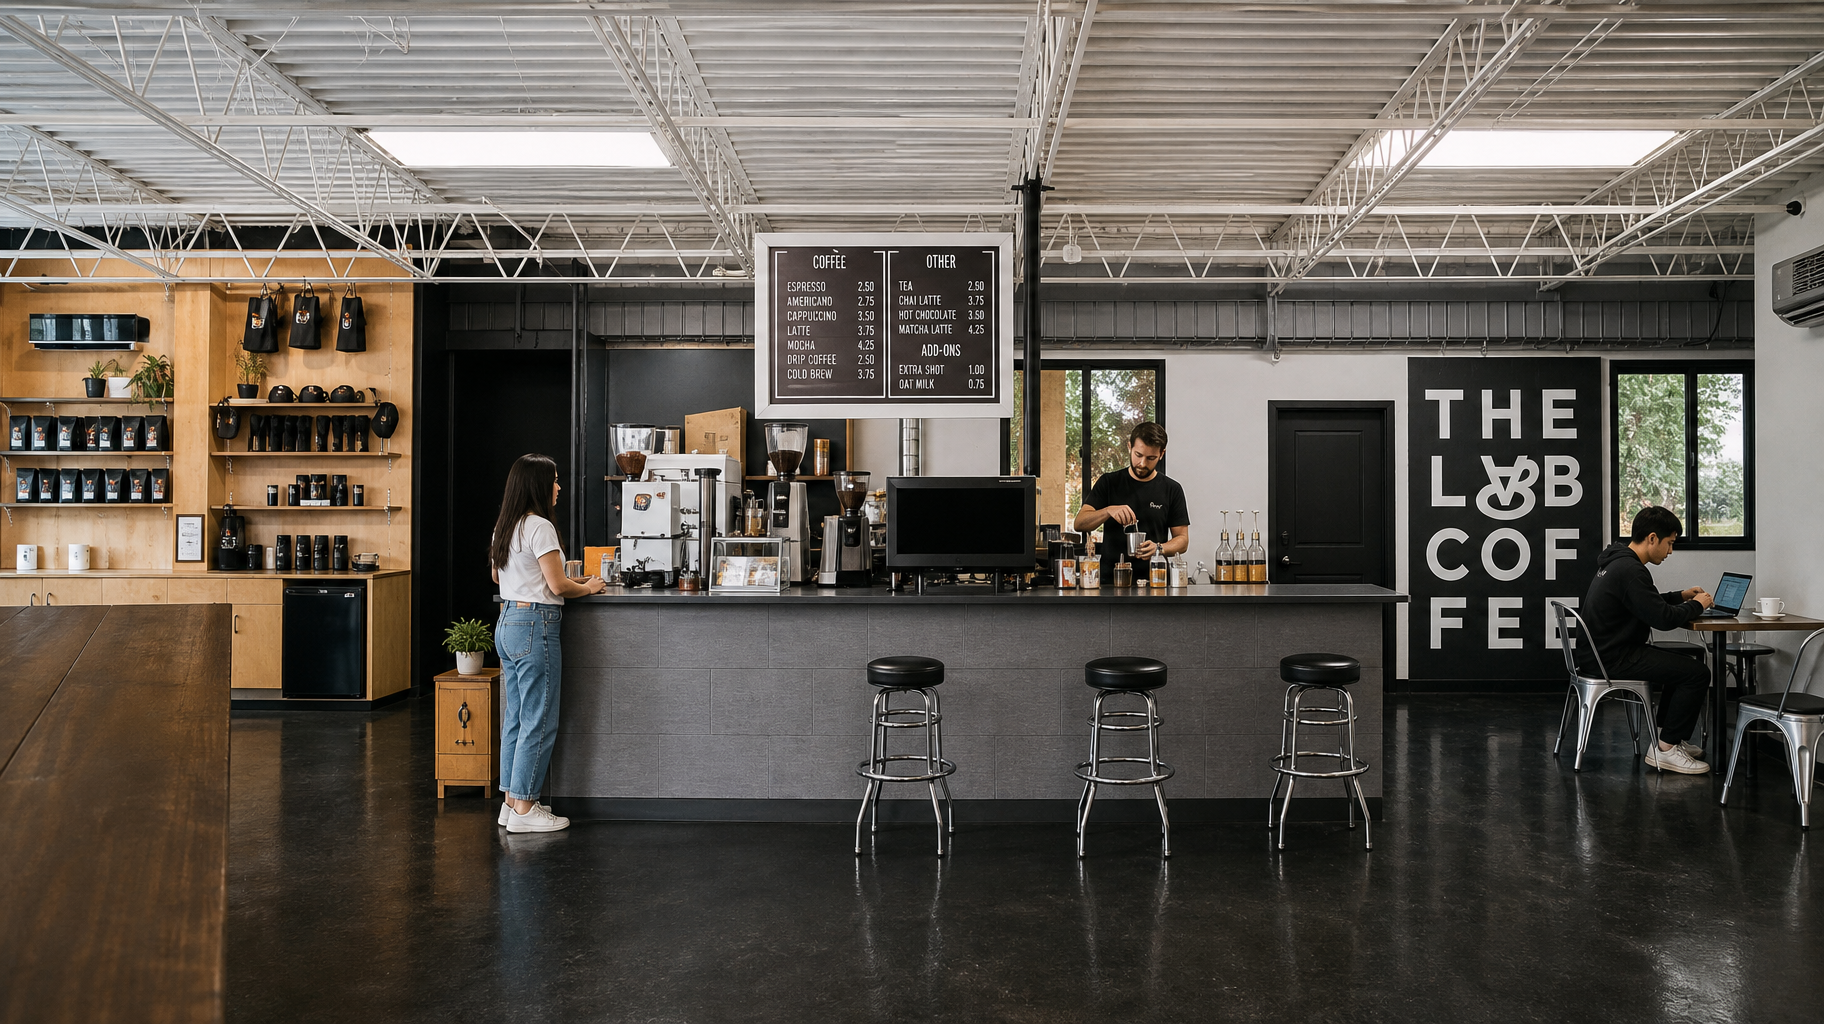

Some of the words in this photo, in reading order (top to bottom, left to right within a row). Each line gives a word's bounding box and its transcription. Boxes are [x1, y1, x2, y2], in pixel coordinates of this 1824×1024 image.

[926, 255, 957, 269] OTHER
[787, 282, 826, 293] ESPRESSO
[857, 281, 875, 292] 2.50
[898, 281, 914, 292] TEA
[967, 281, 985, 292] 2.50
[786, 296, 833, 307] AMERICANO
[857, 296, 875, 307] 2.75
[898, 295, 917, 306] CHAI
[918, 295, 942, 306] LATTE
[967, 295, 985, 306] 3.75
[787, 311, 837, 322] CAPPUCCINO
[857, 311, 875, 322] 3.50
[898, 310, 914, 321] HOT
[914, 310, 957, 321] CHOCOLATE
[967, 310, 985, 321] 3.50
[787, 326, 811, 337] LATTE
[857, 325, 875, 336] 3.75
[898, 324, 930, 335] MATCHA
[930, 324, 953, 335] LATTE
[967, 324, 985, 335] 4.25
[787, 340, 816, 351] MOCHA
[857, 340, 875, 351] 4.25
[920, 344, 961, 357] ADD-ONS
[787, 354, 806, 365] DRIP
[807, 354, 837, 366] COFFEE
[857, 354, 875, 365] 2.50
[787, 369, 808, 380] COLD
[810, 369, 833, 380] BREW
[857, 369, 875, 380] 3.75
[898, 364, 923, 375] EXTRA
[924, 364, 945, 375] SHOT
[968, 364, 985, 375] 1.00
[898, 379, 915, 390] OAT
[915, 379, 935, 390] MILK
[968, 379, 985, 390] 0.75
[1425, 389, 1577, 439] THE
[1426, 528, 1579, 581] COF
[1431, 597, 1579, 649] FEE
